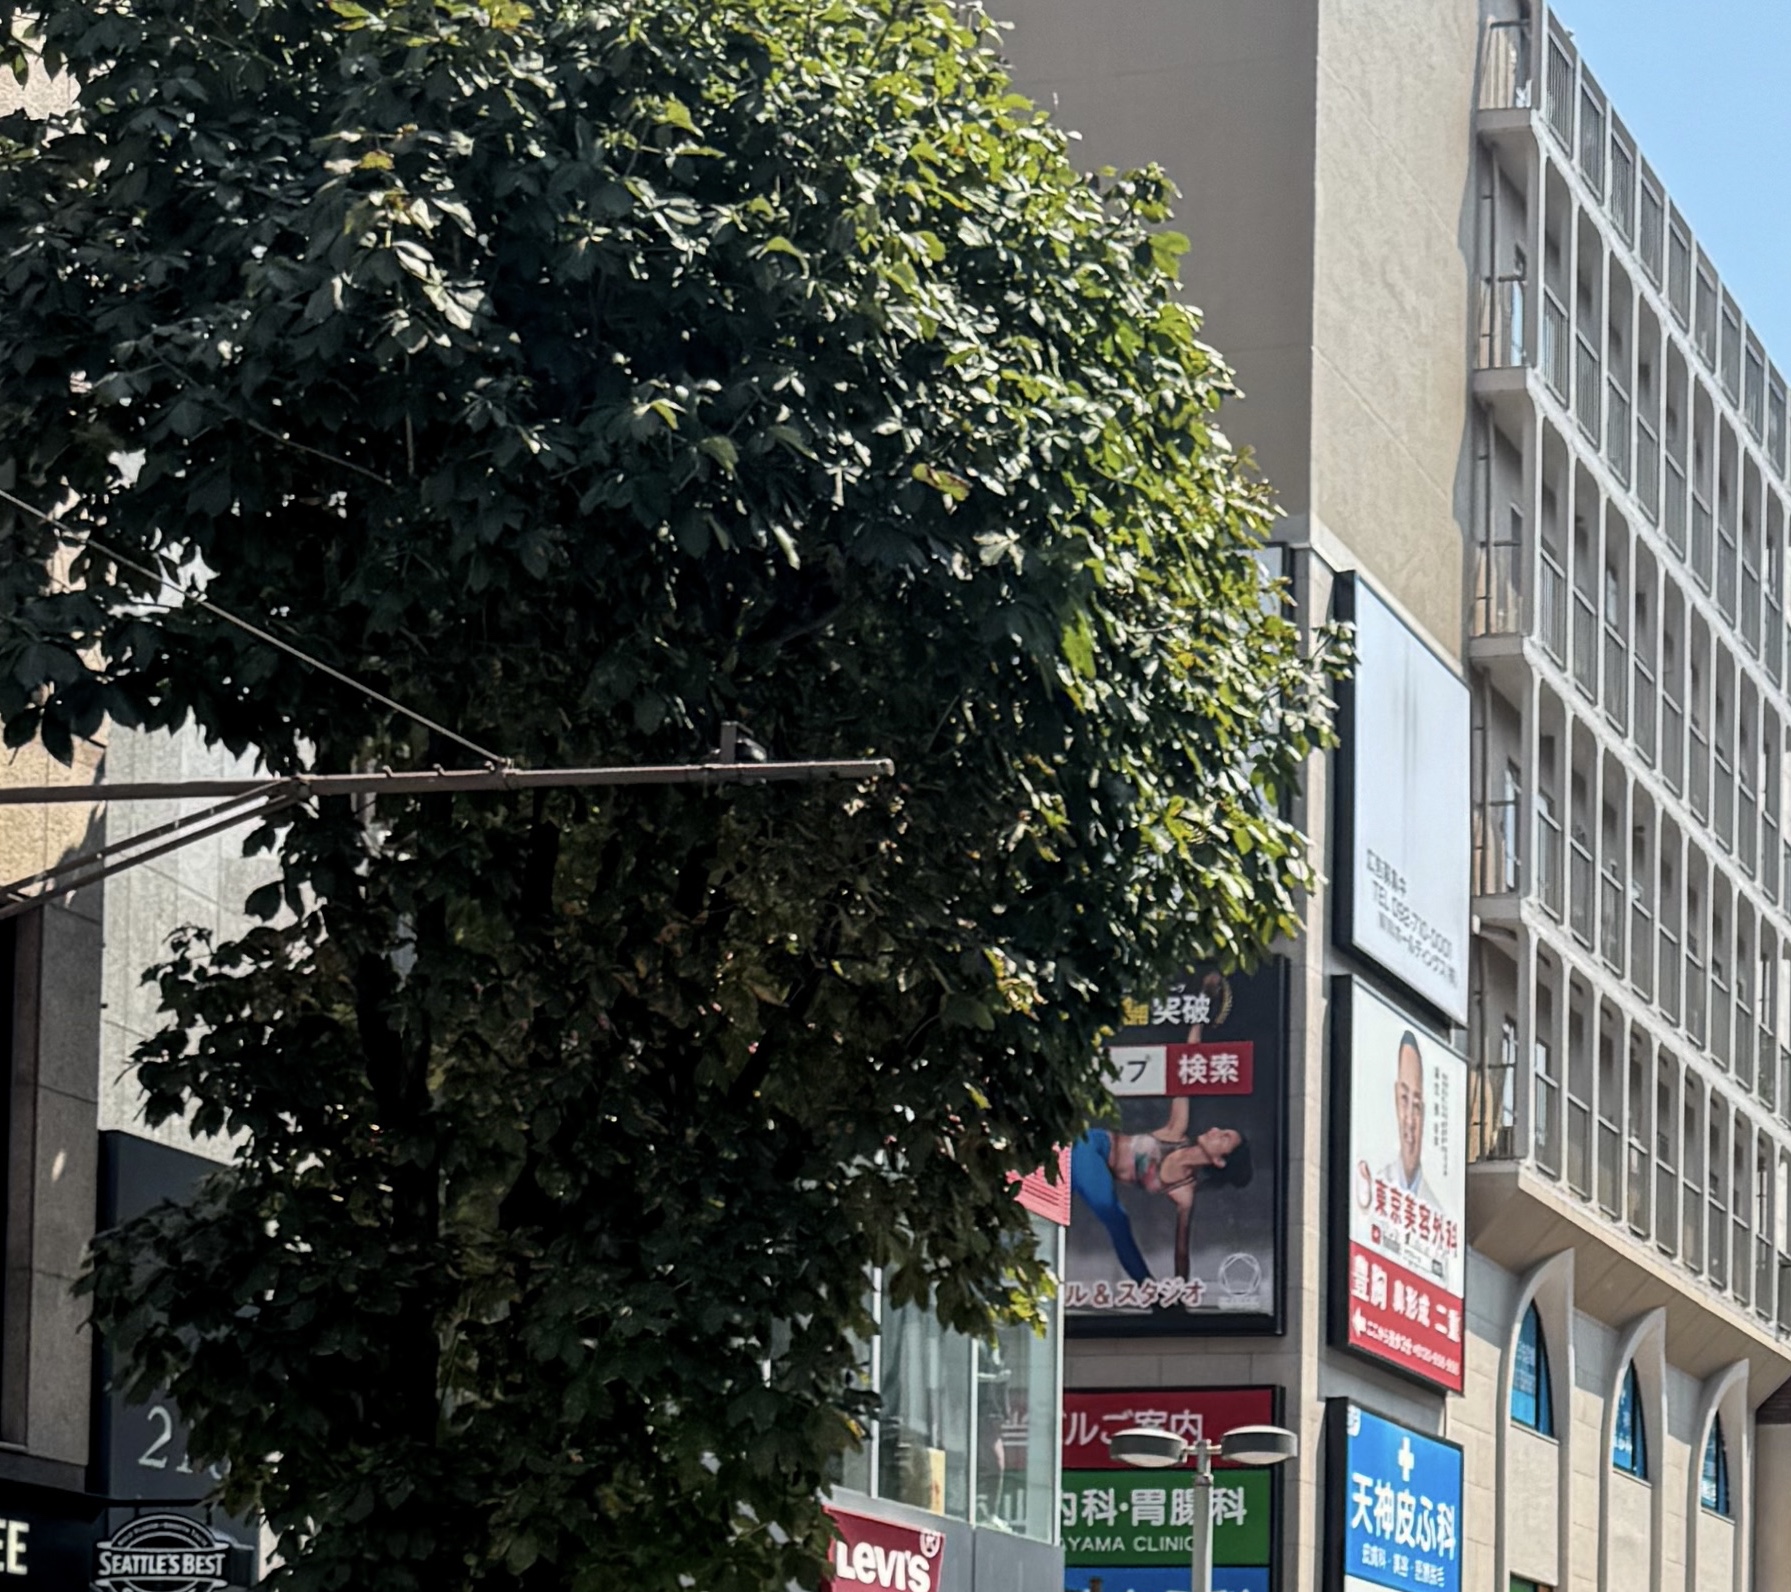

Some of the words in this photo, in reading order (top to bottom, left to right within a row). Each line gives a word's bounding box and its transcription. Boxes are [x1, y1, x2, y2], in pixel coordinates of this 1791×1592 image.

[1177, 1053, 1240, 1085] 検索
[1351, 1471, 1457, 1561] 天神皮ふ科
[98, 1550, 180, 1577] SEATTLE'S
[181, 1552, 226, 1577] BEST
